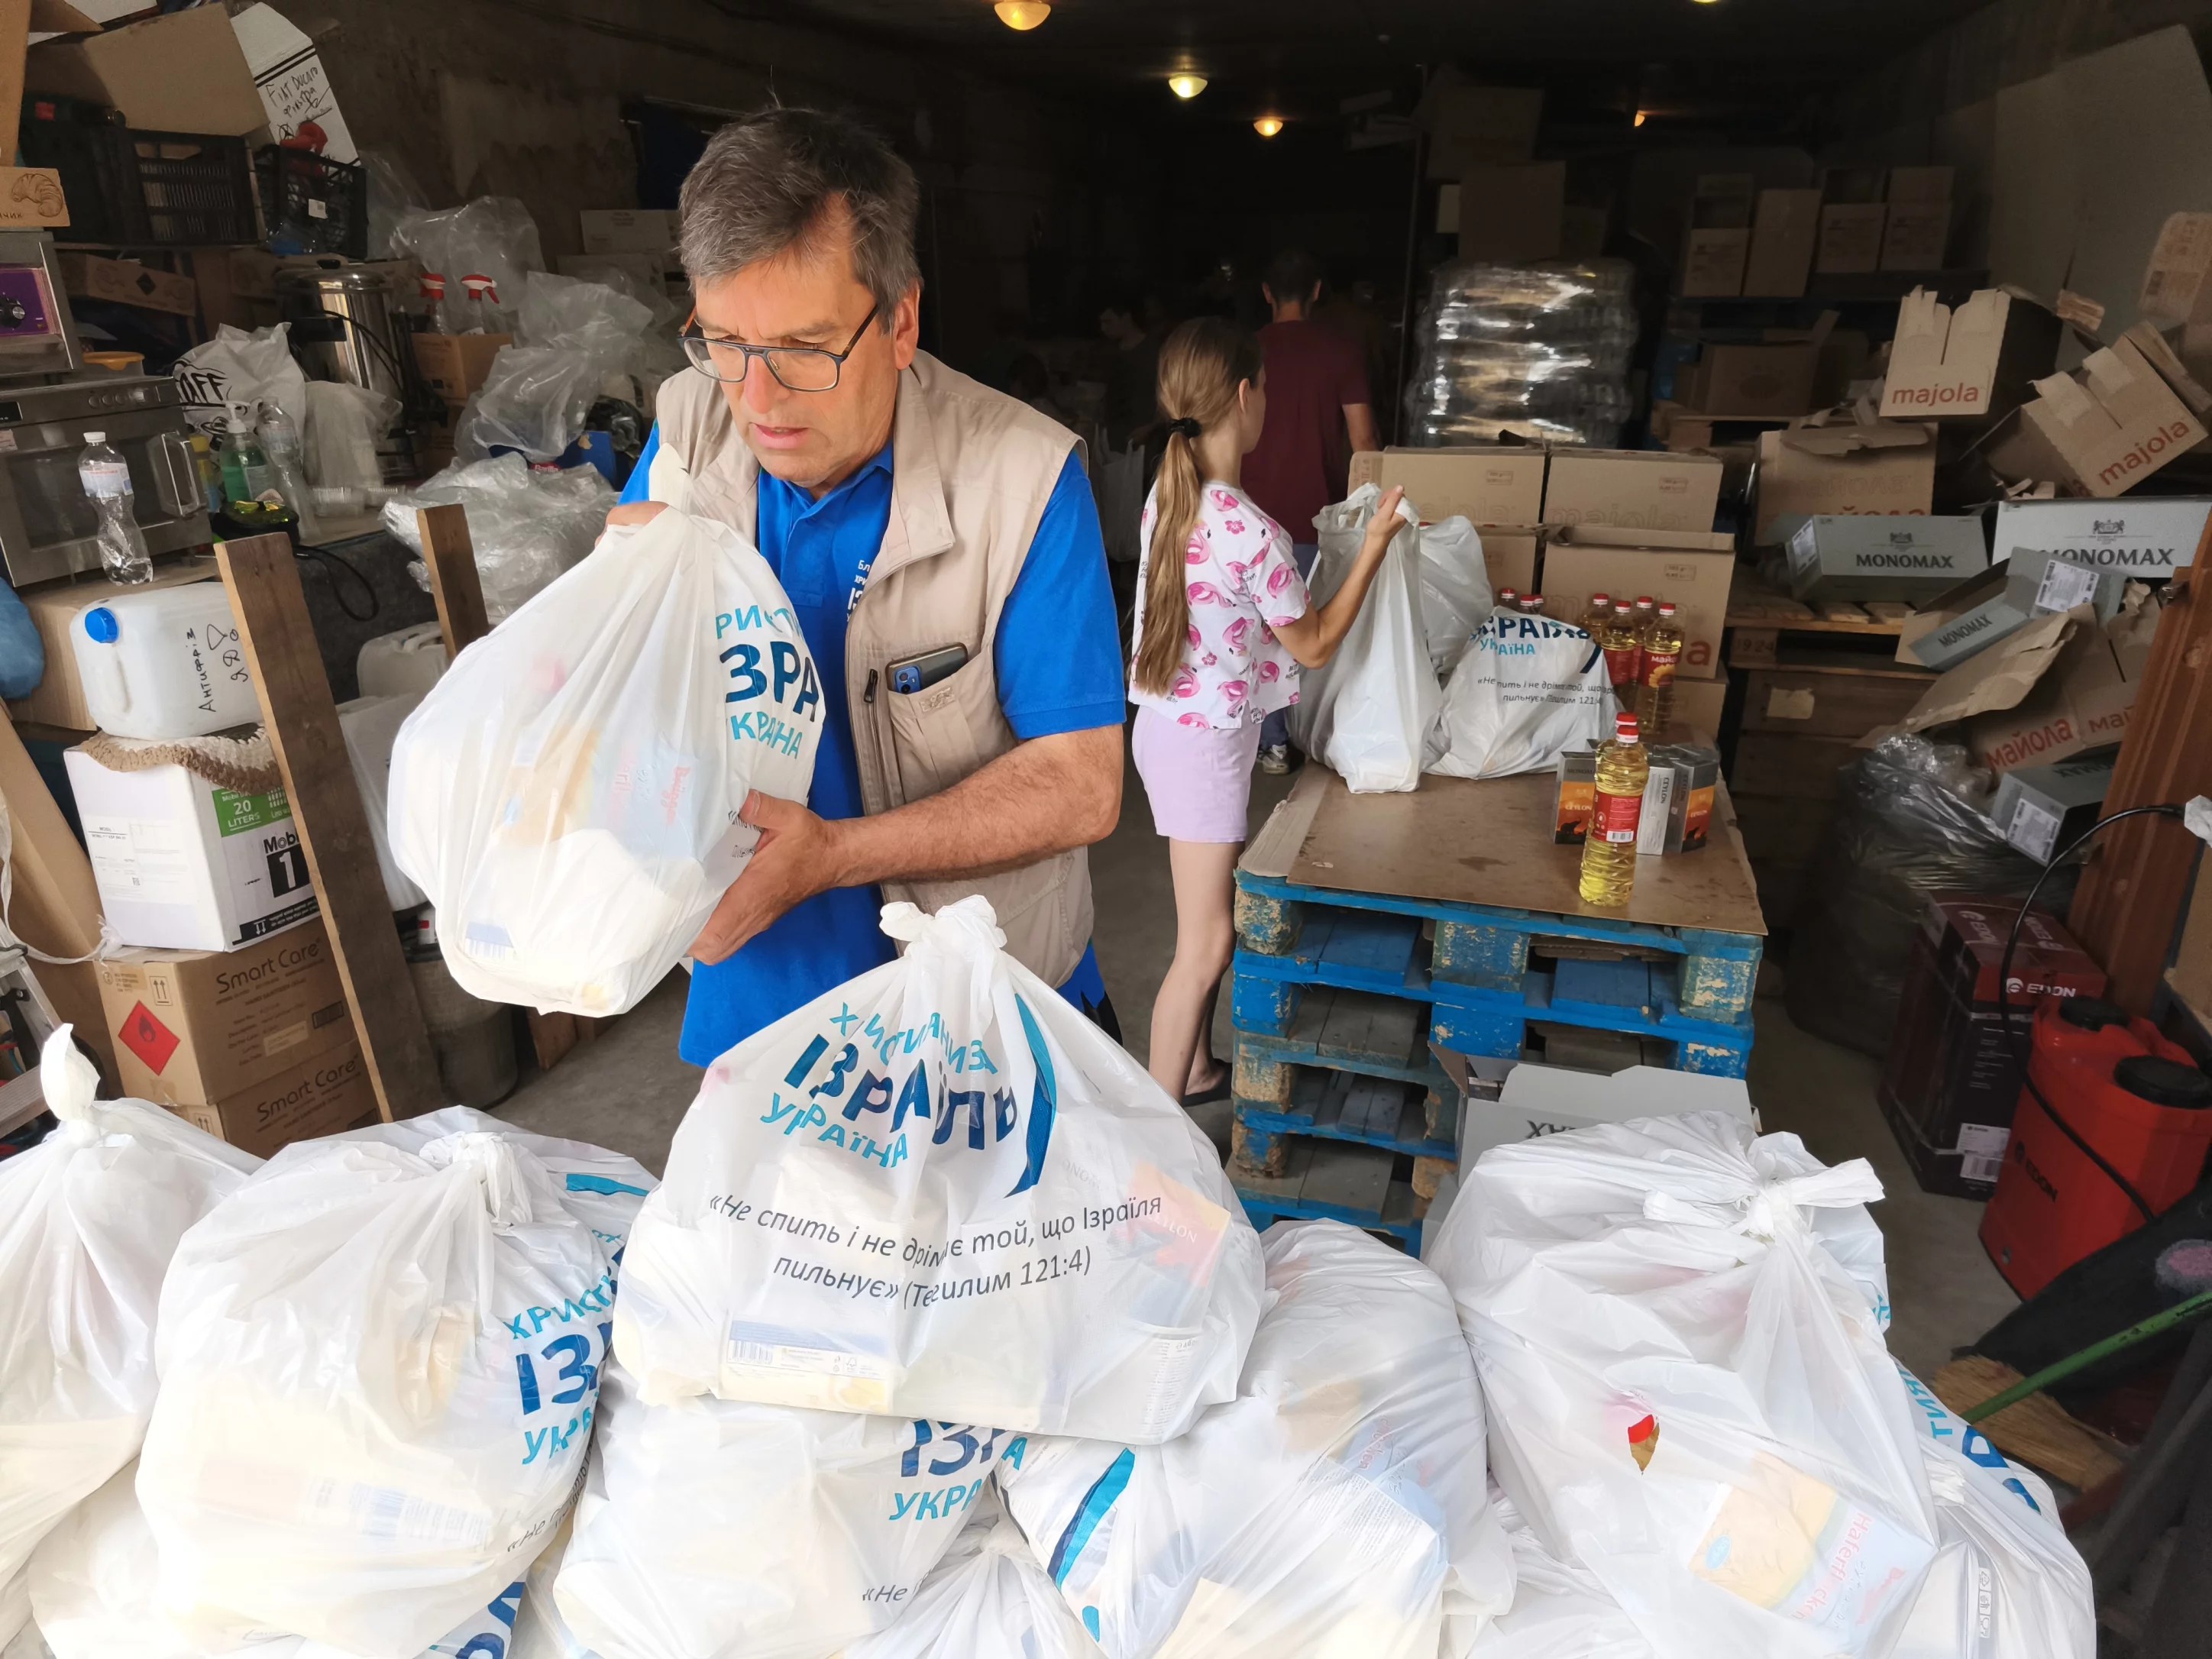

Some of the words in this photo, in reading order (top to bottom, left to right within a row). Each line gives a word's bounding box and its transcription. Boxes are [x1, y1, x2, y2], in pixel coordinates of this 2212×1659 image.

[1891, 383, 1979, 407] majola
[2097, 417, 2191, 487] majola
[1856, 553, 1954, 570] MONOMAX
[1938, 614, 1993, 648] MONOMAX
[1661, 777, 1670, 804] CEYLON
[228, 812, 260, 827] LITERS
[234, 800, 252, 816] 20
[216, 958, 276, 994] Smart
[278, 943, 319, 968] Care
[257, 1081, 313, 1123] Smart
[315, 1059, 355, 1088] Care
[710, 1195, 752, 1221] «Не
[757, 1209, 841, 1244] спить
[847, 1225, 860, 1247] і
[862, 1234, 897, 1256] не
[972, 1220, 1035, 1255] той,
[1041, 1216, 1075, 1241] що
[1083, 1196, 1162, 1231] Ізраїля
[773, 1256, 899, 1299] пильнує»
[1020, 1245, 1091, 1285] 121:4)
[862, 1584, 908, 1603] «Не
